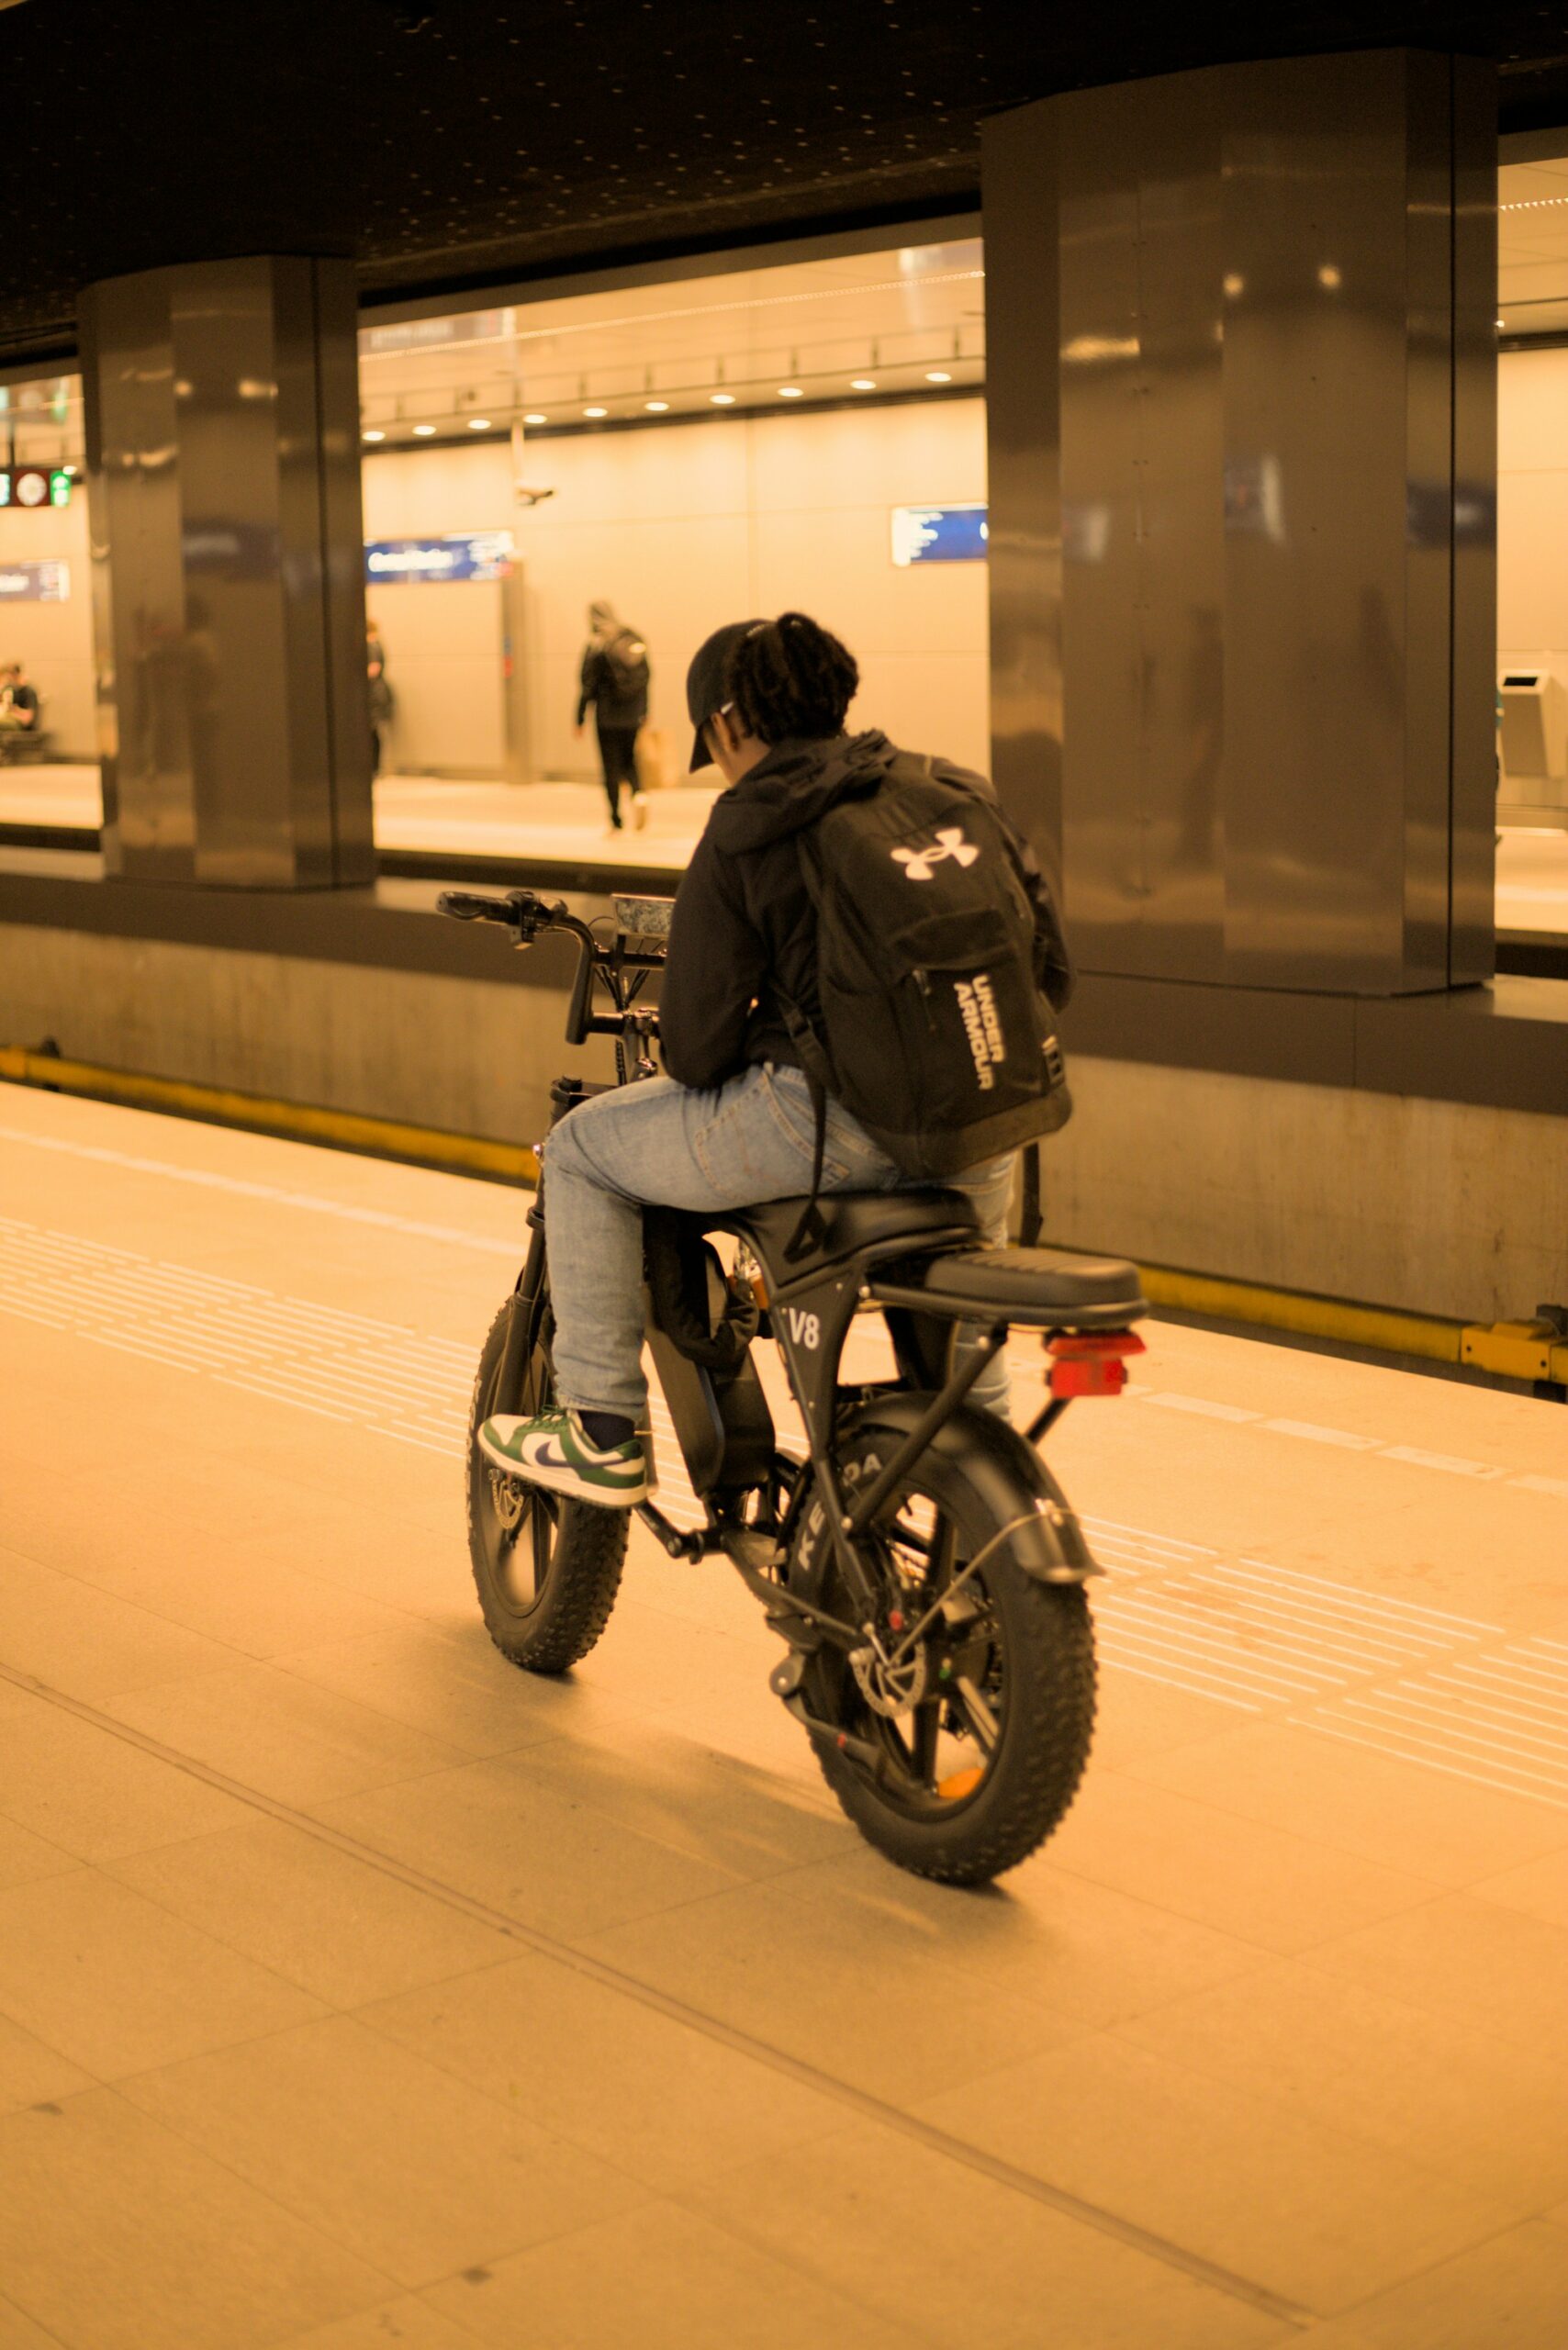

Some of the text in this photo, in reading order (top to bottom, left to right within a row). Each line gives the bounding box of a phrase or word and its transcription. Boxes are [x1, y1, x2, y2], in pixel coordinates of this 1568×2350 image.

[954, 982, 993, 1090] ARMOUR
[972, 975, 1004, 1062] UNDER
[789, 1307, 820, 1349] V8
[798, 1453, 882, 1571] KEDA
